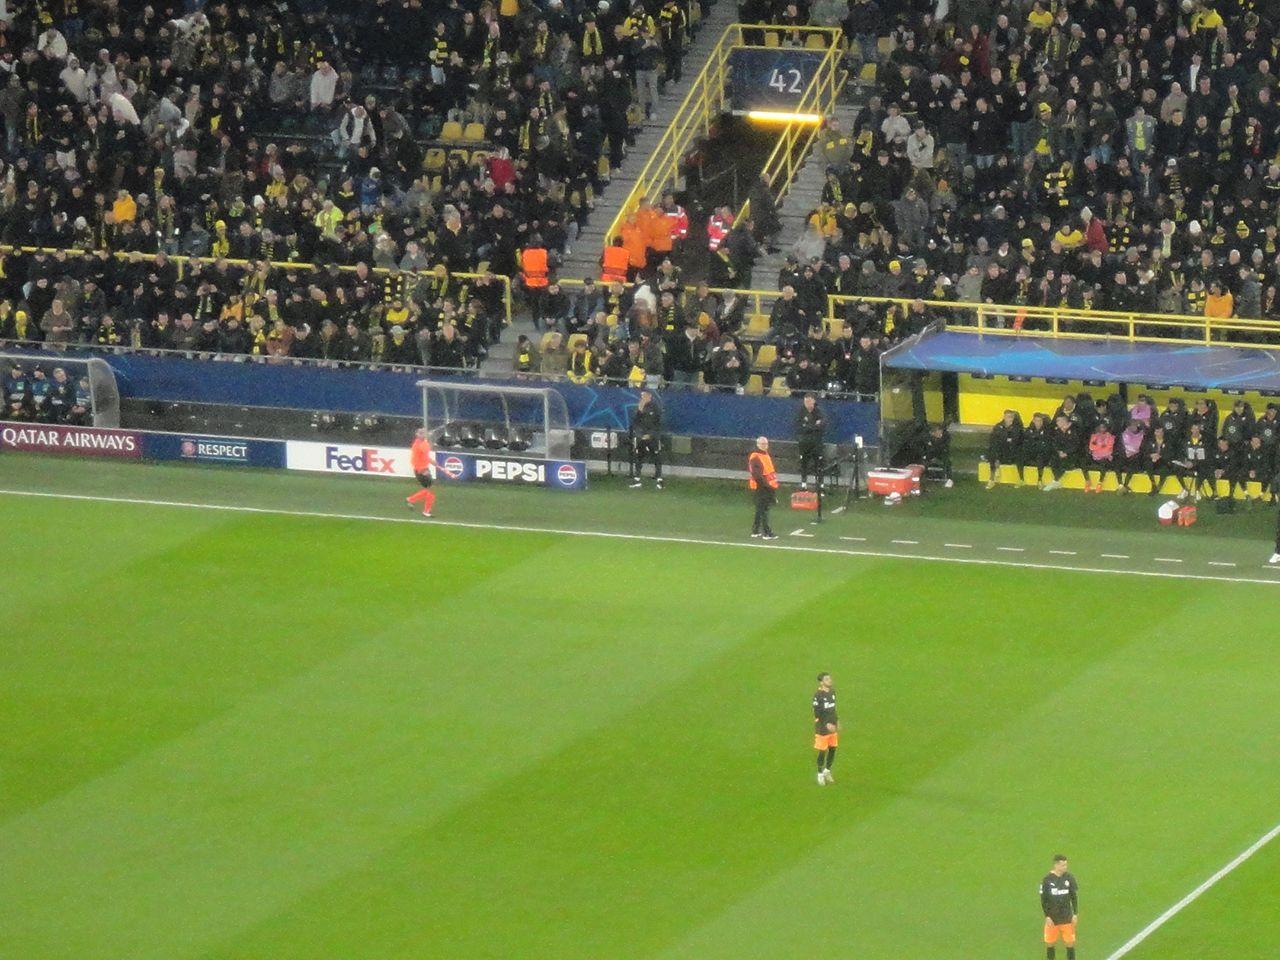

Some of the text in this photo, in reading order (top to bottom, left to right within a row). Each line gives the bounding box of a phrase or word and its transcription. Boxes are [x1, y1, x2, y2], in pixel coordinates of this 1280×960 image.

[769, 69, 802, 93] 42
[2, 428, 135, 451] QATAR AIRWAYS
[198, 443, 247, 457] RESPECT
[326, 447, 395, 473] FedEx
[476, 460, 545, 482] PEPSI
